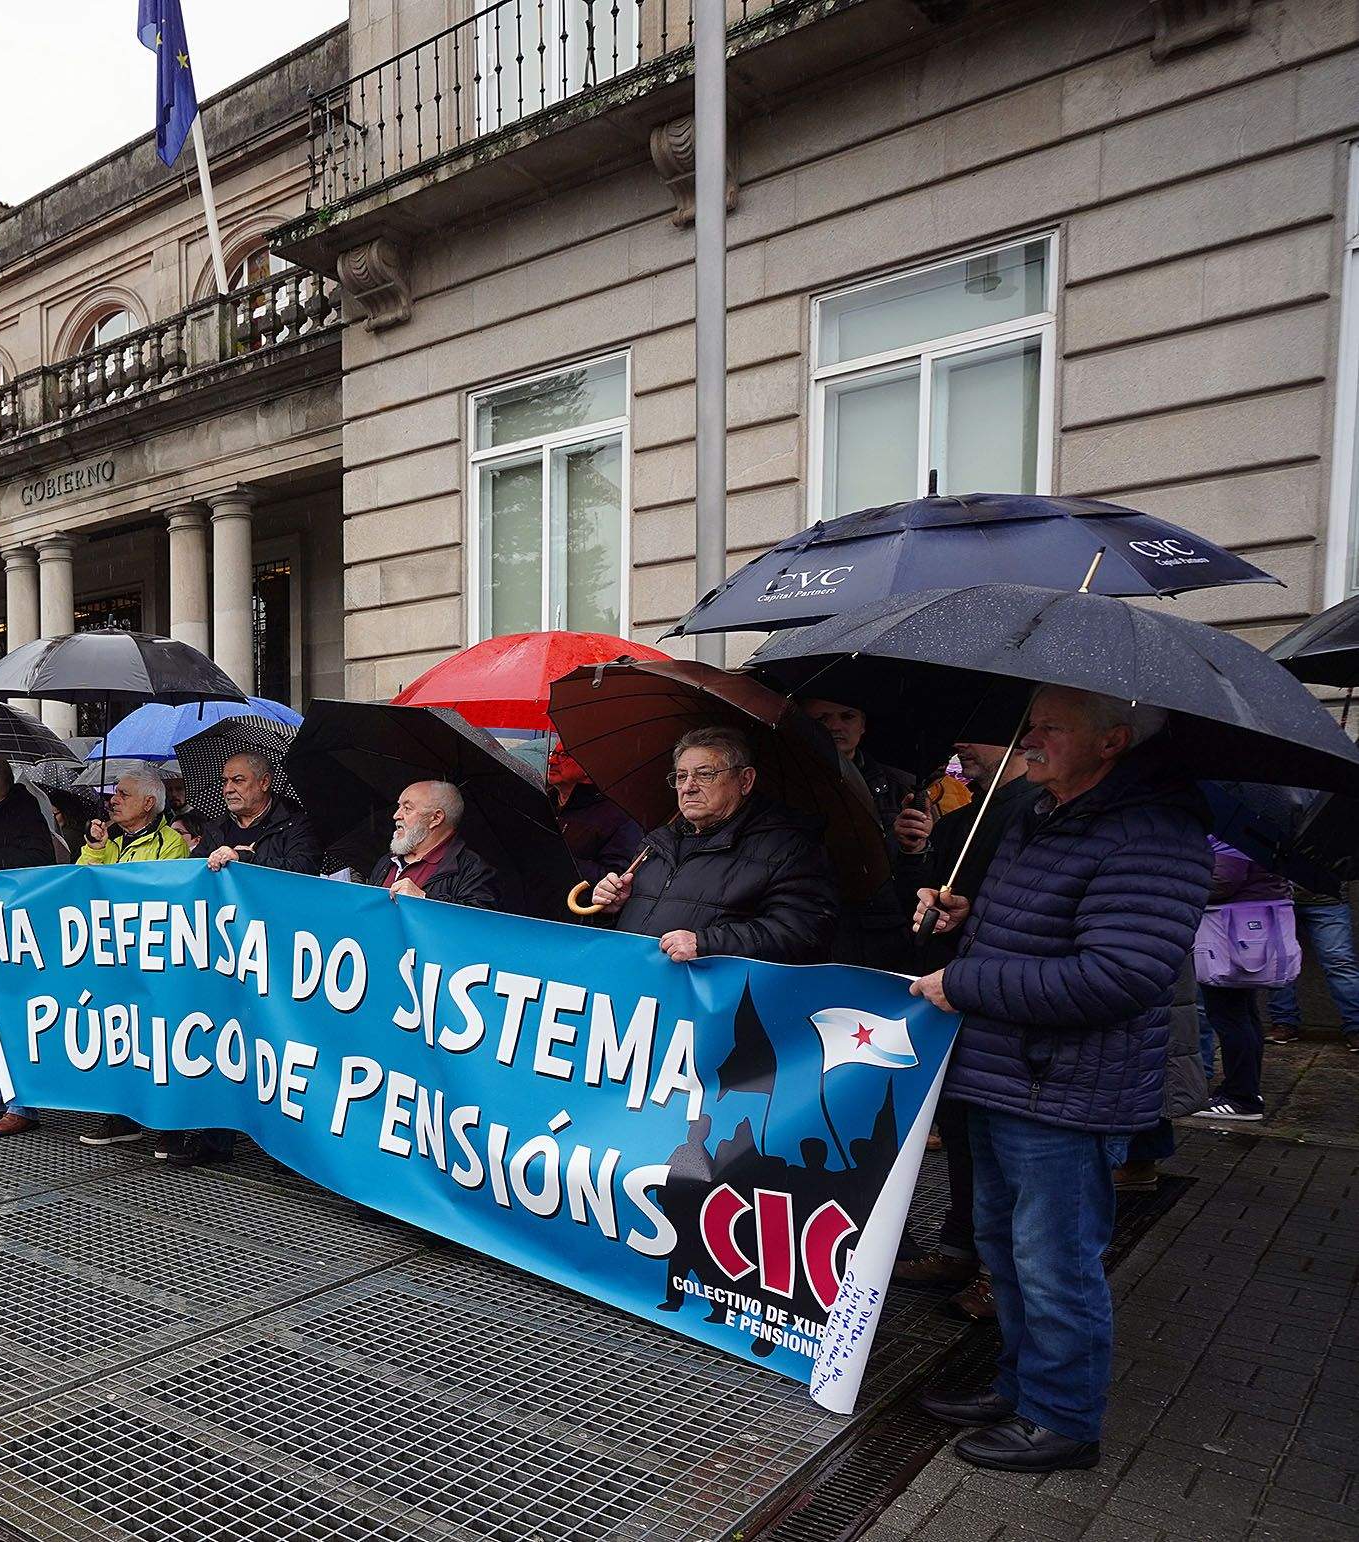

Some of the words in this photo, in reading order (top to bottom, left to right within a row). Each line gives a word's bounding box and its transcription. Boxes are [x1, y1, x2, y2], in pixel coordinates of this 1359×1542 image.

[20, 459, 116, 506] GOBIERNO
[1129, 539, 1194, 557] CVC
[757, 592, 793, 602] Capital
[794, 588, 837, 598] Partners
[765, 565, 854, 592] CVC
[59, 899, 270, 996] DEFENSA
[291, 930, 367, 1012] DO
[392, 948, 704, 1121] SISTEMA
[26, 988, 247, 1086] PÚBLICO
[255, 1038, 319, 1121] DE
[329, 1054, 679, 1258] PENSIÓNS
[672, 1275, 762, 1316] COLECTIVO
[765, 1304, 789, 1328] DE
[792, 1314, 826, 1341] XUB
[724, 1308, 737, 1328] E
